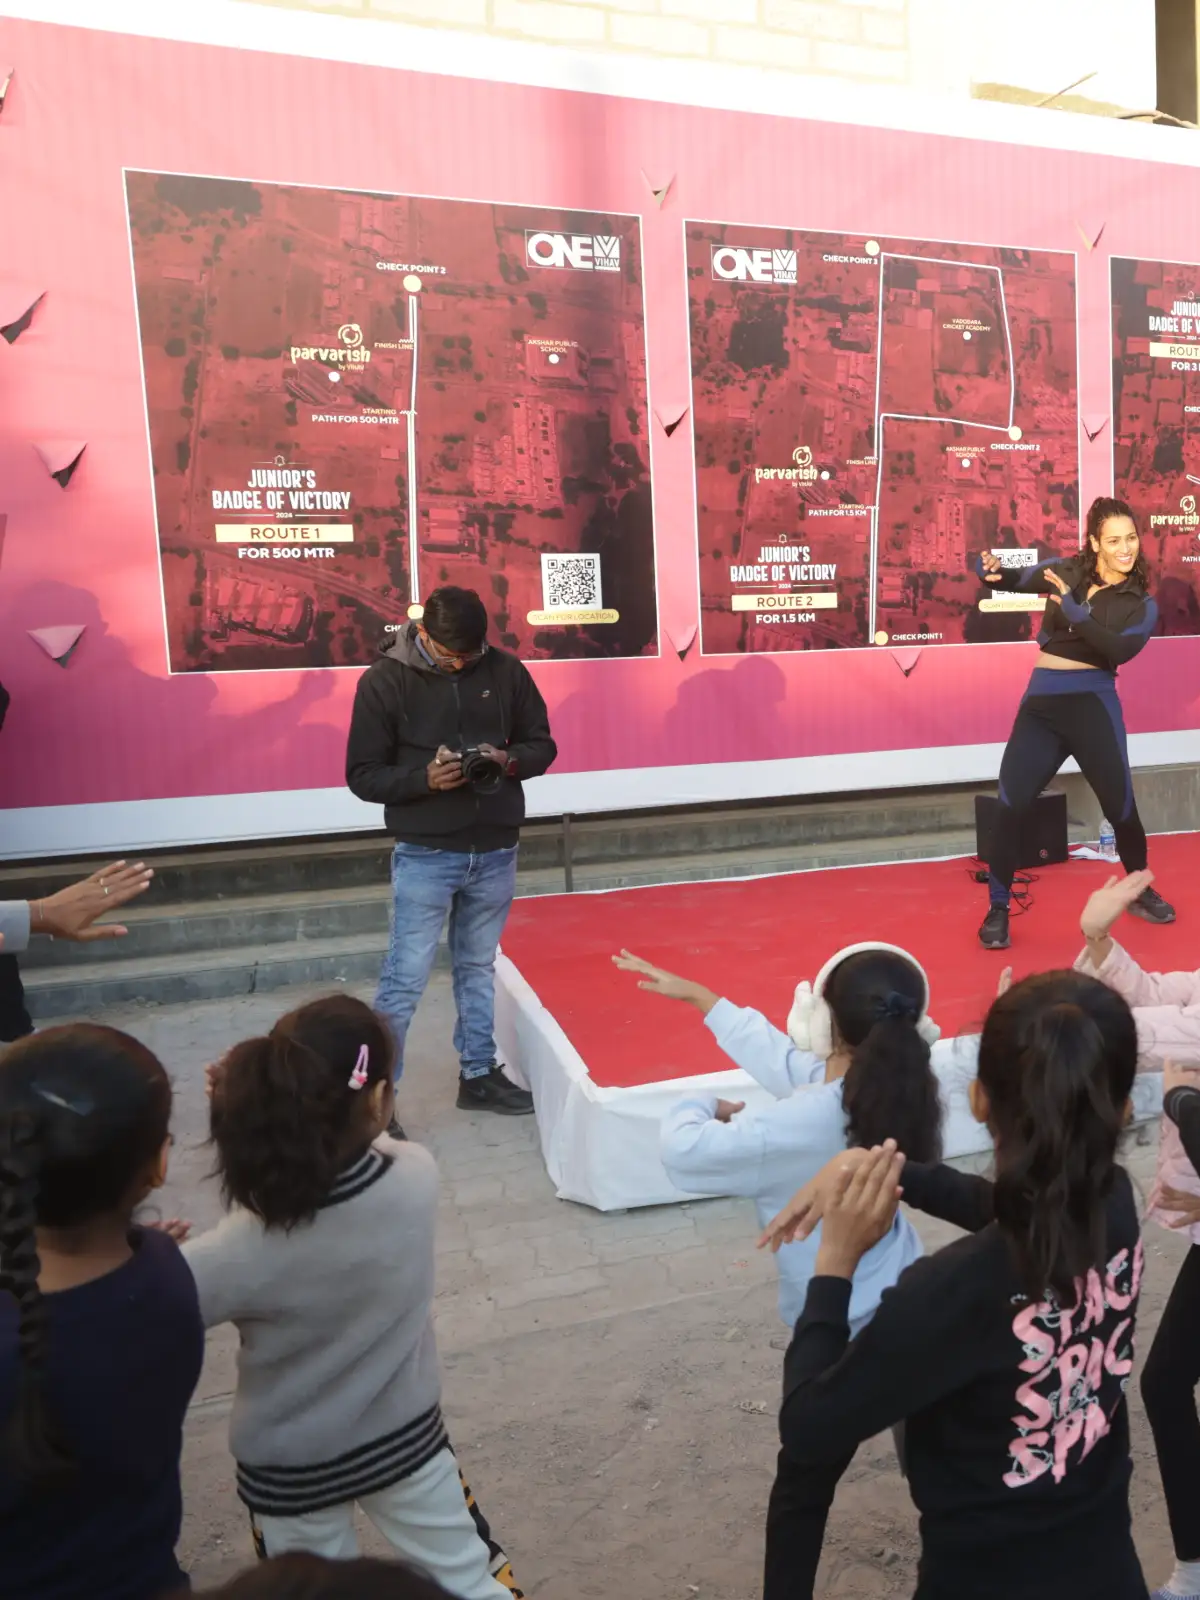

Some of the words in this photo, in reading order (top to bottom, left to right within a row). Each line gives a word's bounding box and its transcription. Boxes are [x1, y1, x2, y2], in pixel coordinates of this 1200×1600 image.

[527, 232, 593, 269] ONE
[376, 262, 409, 271] CHECK
[410, 265, 438, 273] POINT
[713, 247, 773, 281] ONE
[823, 254, 848, 263] CHECK
[849, 257, 873, 265] POINT
[1148, 315, 1179, 332] BADGE
[1181, 318, 1193, 333] OF
[290, 345, 371, 364] parvarish
[1171, 361, 1190, 371] FOR
[1191, 363, 1197, 371] 3
[312, 415, 336, 423] PATH
[338, 415, 358, 424] FOR
[360, 416, 378, 424] 500
[379, 416, 400, 424] MTR
[248, 469, 316, 488] JUNIOR'S
[755, 465, 818, 484] parvarish
[212, 490, 262, 509] BADGE
[266, 490, 285, 509] OF
[288, 491, 350, 510] VICTORY
[1150, 512, 1200, 528] parvarish
[250, 527, 310, 539] ROUTE
[314, 527, 320, 539] 1
[238, 548, 270, 558] FOR
[273, 548, 301, 558] 500
[304, 548, 335, 558] MTR
[757, 546, 811, 563] JUNIOR'S
[730, 565, 768, 582] BADGE
[771, 565, 786, 581] OF
[789, 564, 836, 580] VICTORY
[757, 596, 803, 607] ROUTE
[806, 596, 813, 606] 2
[756, 614, 780, 624] FOR
[782, 613, 796, 623] 1.5
[798, 612, 815, 623] KM
